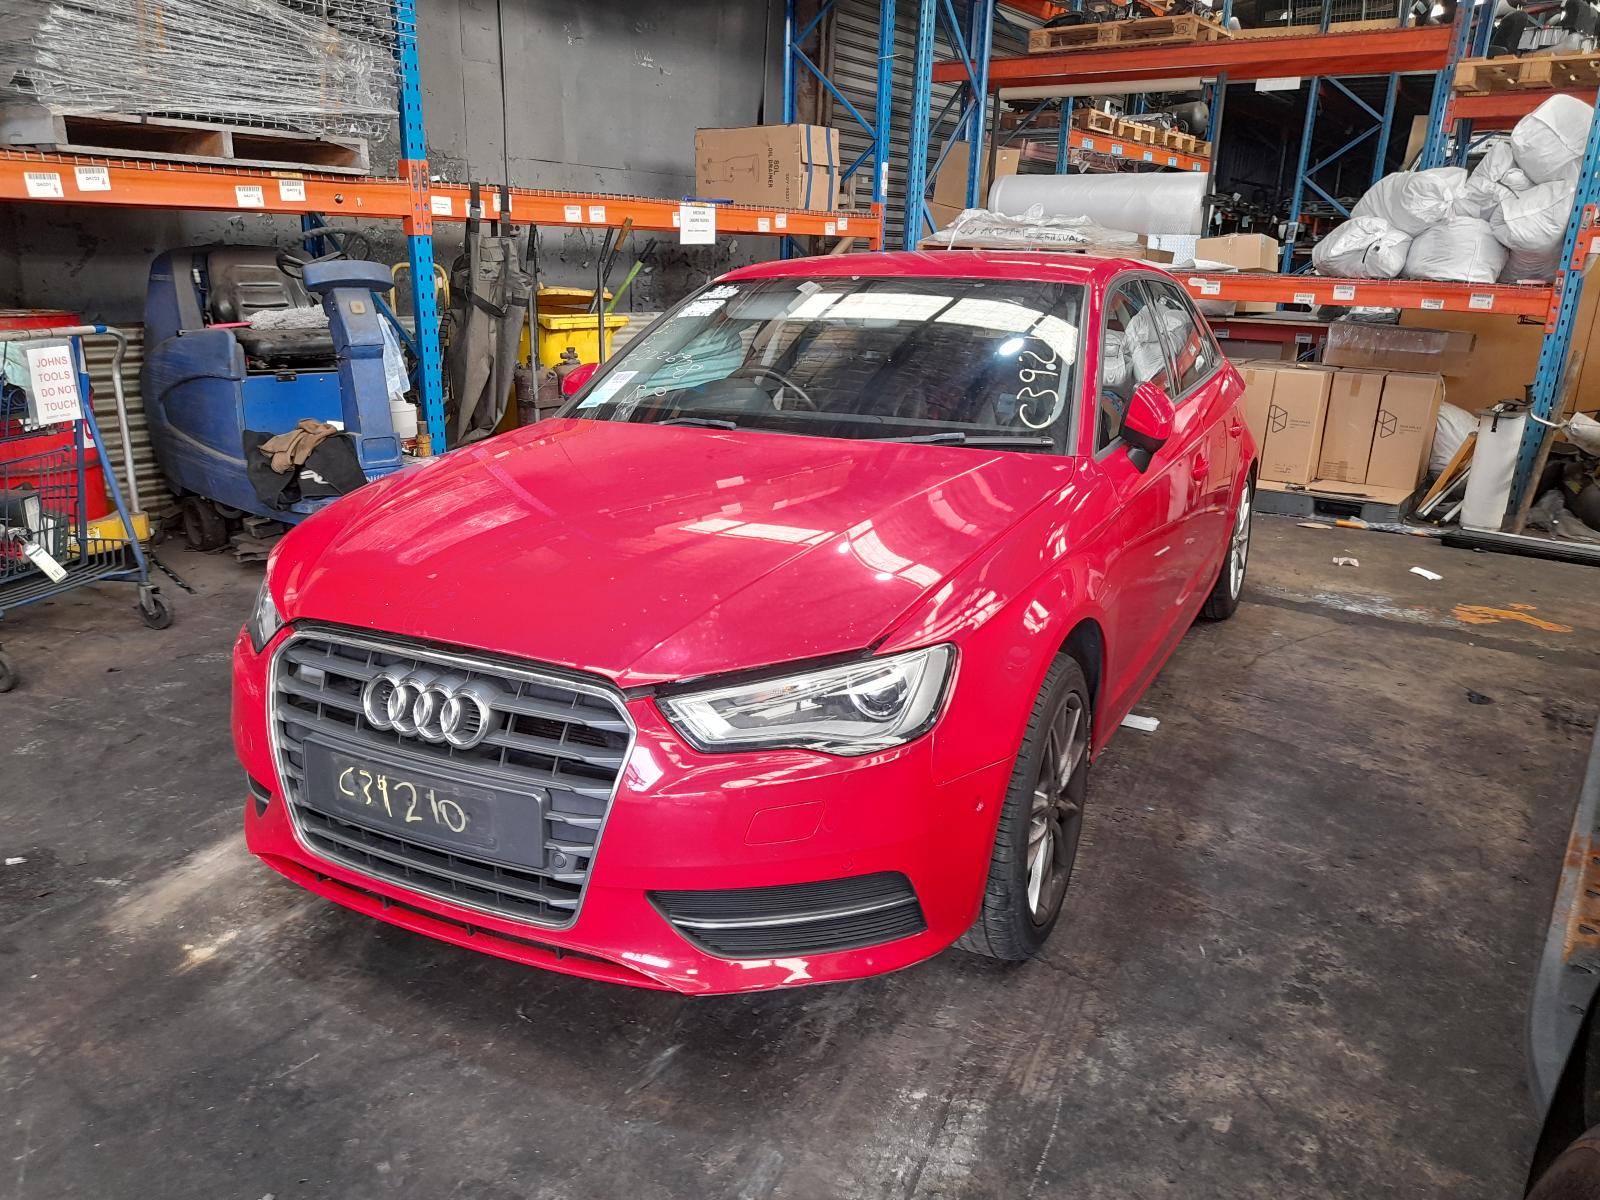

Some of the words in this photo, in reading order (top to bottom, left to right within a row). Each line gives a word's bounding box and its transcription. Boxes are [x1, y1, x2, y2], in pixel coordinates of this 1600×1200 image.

[36, 356, 68, 368] JOHNS
[38, 370, 71, 382] TOOLS
[41, 387, 56, 397] DO
[57, 384, 77, 395] NOT
[44, 399, 77, 411] TOUCH
[339, 766, 467, 833] C39210
